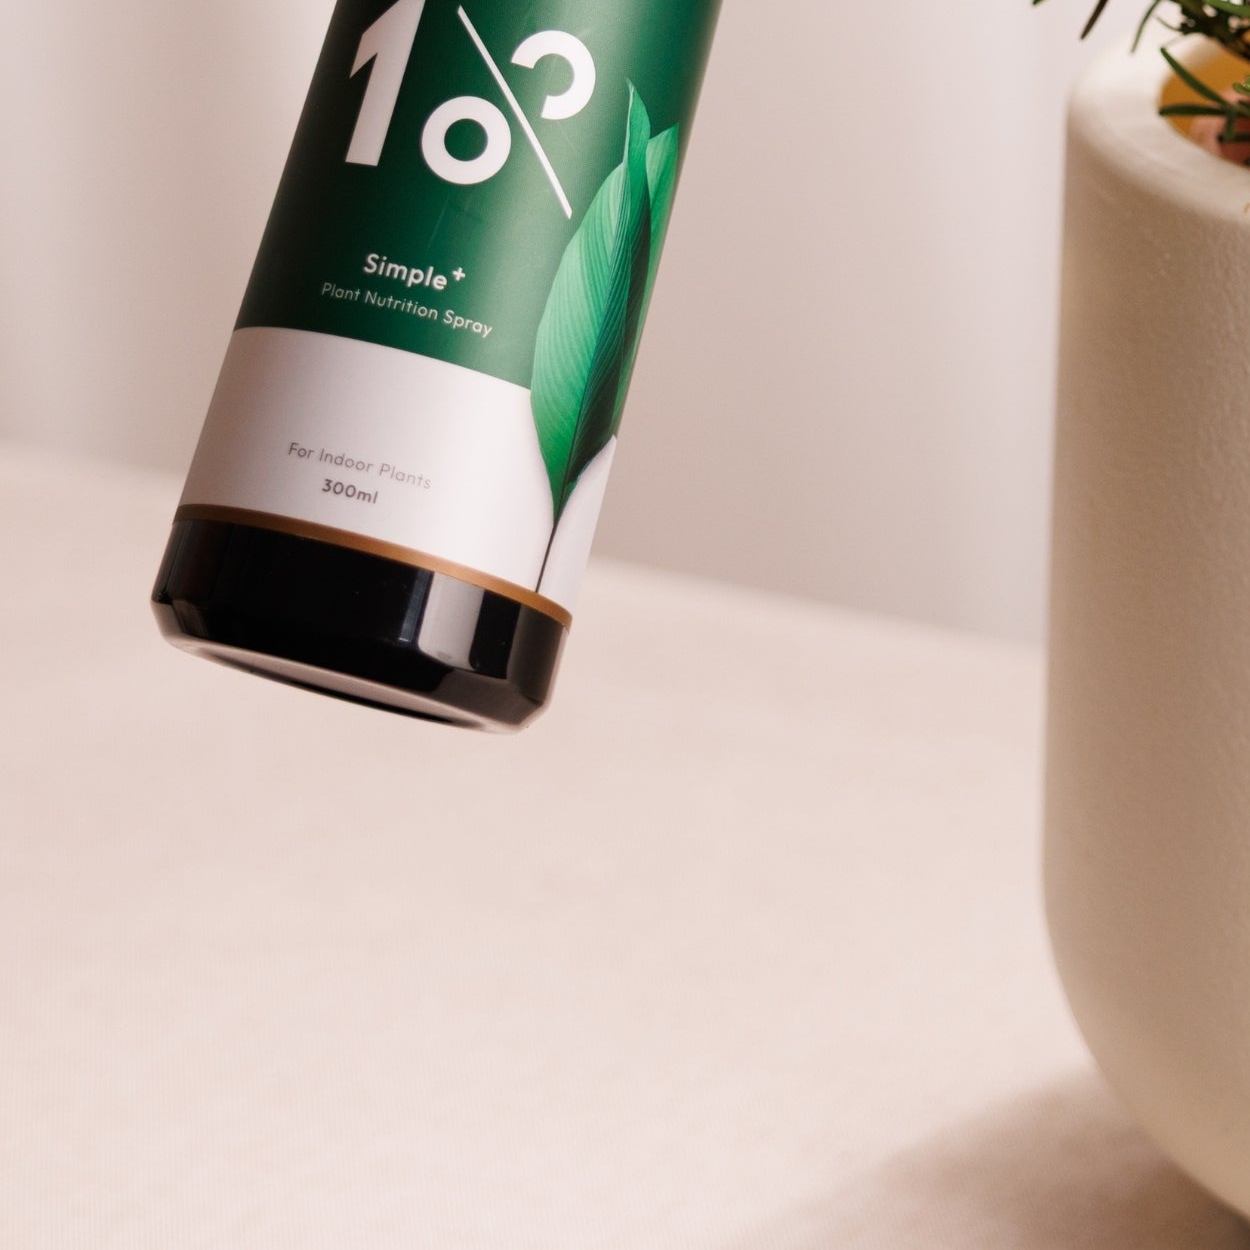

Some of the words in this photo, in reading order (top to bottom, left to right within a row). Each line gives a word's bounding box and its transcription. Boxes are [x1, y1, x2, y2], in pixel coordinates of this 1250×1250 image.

[321, 282, 361, 302] Plant
[364, 290, 439, 320] Nutrition
[442, 310, 494, 338] Spray
[287, 442, 314, 461] For
[318, 448, 374, 473] Indoor
[378, 463, 432, 490] Plants
[321, 478, 379, 504] 300ml
